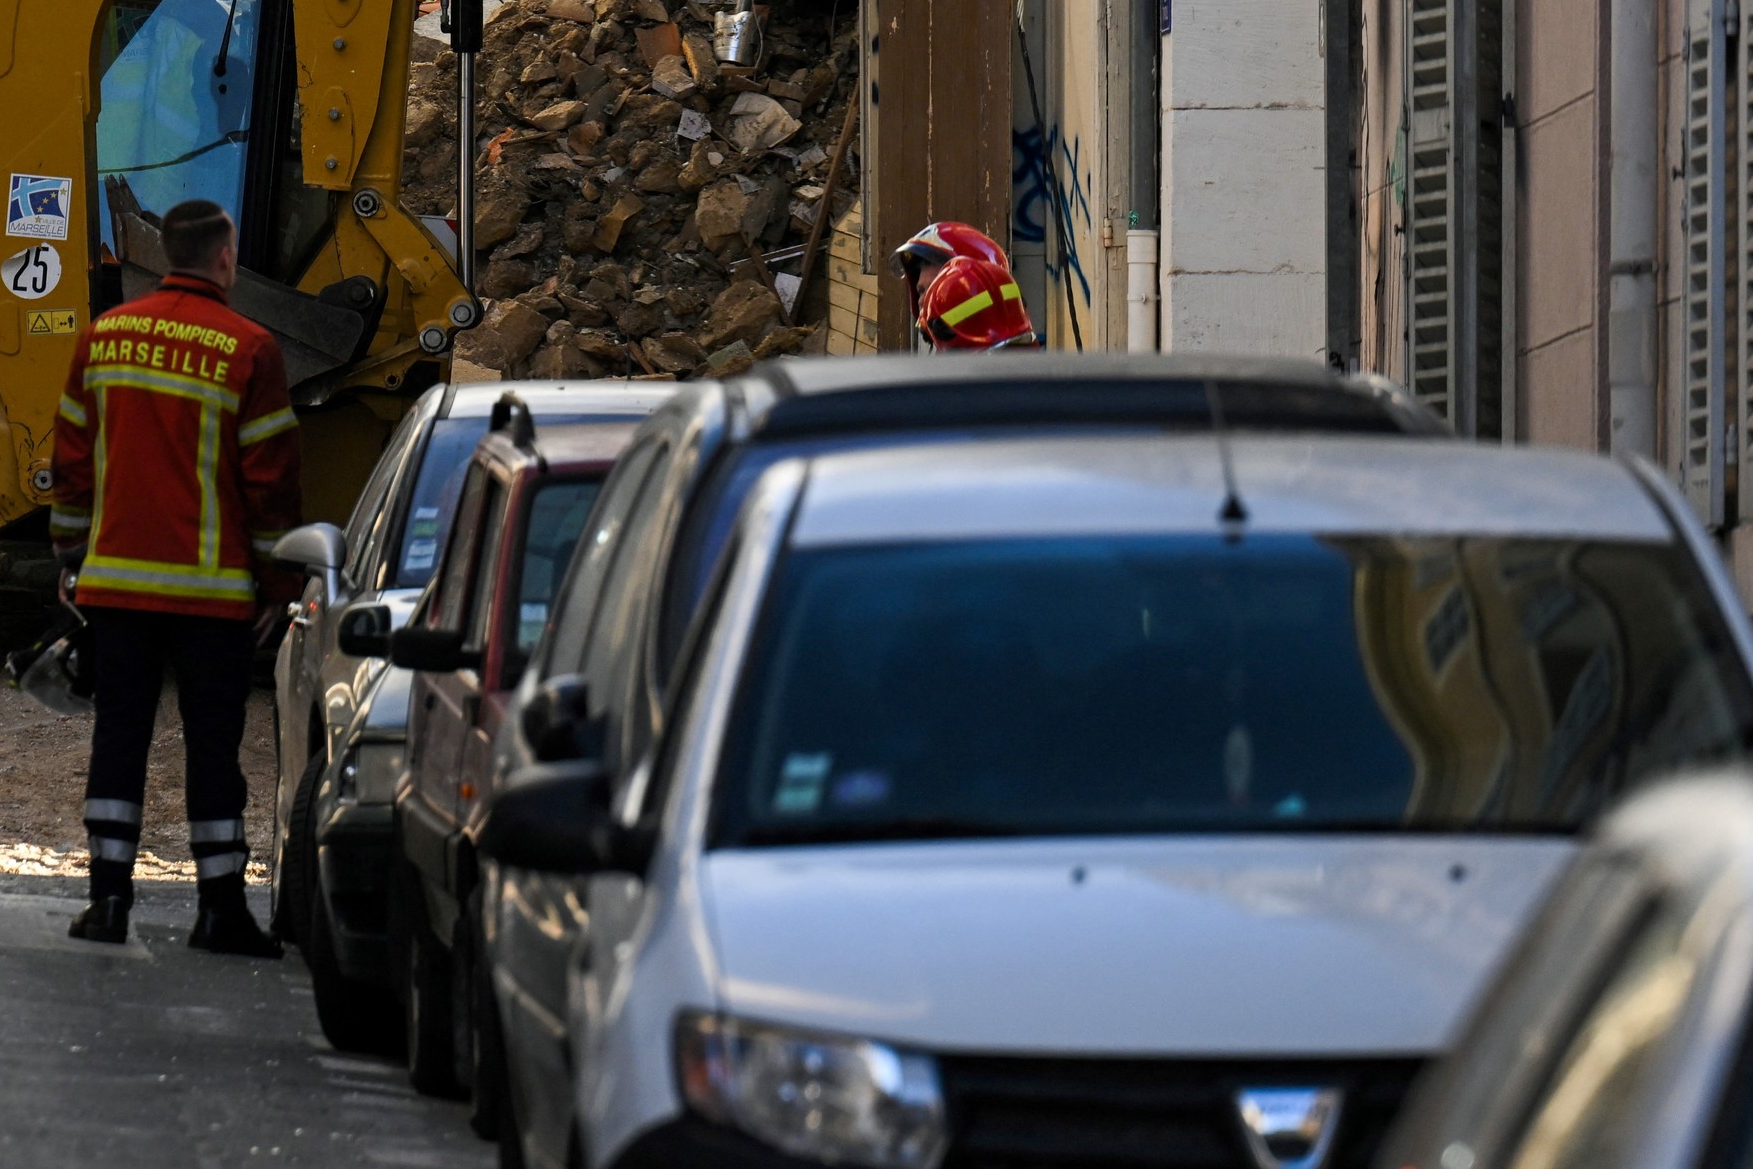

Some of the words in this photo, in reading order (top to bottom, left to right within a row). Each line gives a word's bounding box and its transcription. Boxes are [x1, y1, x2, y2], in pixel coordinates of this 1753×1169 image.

[10, 222, 65, 235] MARSEILLE
[12, 247, 50, 294] 25
[95, 315, 153, 334] MARINS
[153, 319, 239, 356] POMPIERS
[89, 339, 230, 383] MARSEILLE
